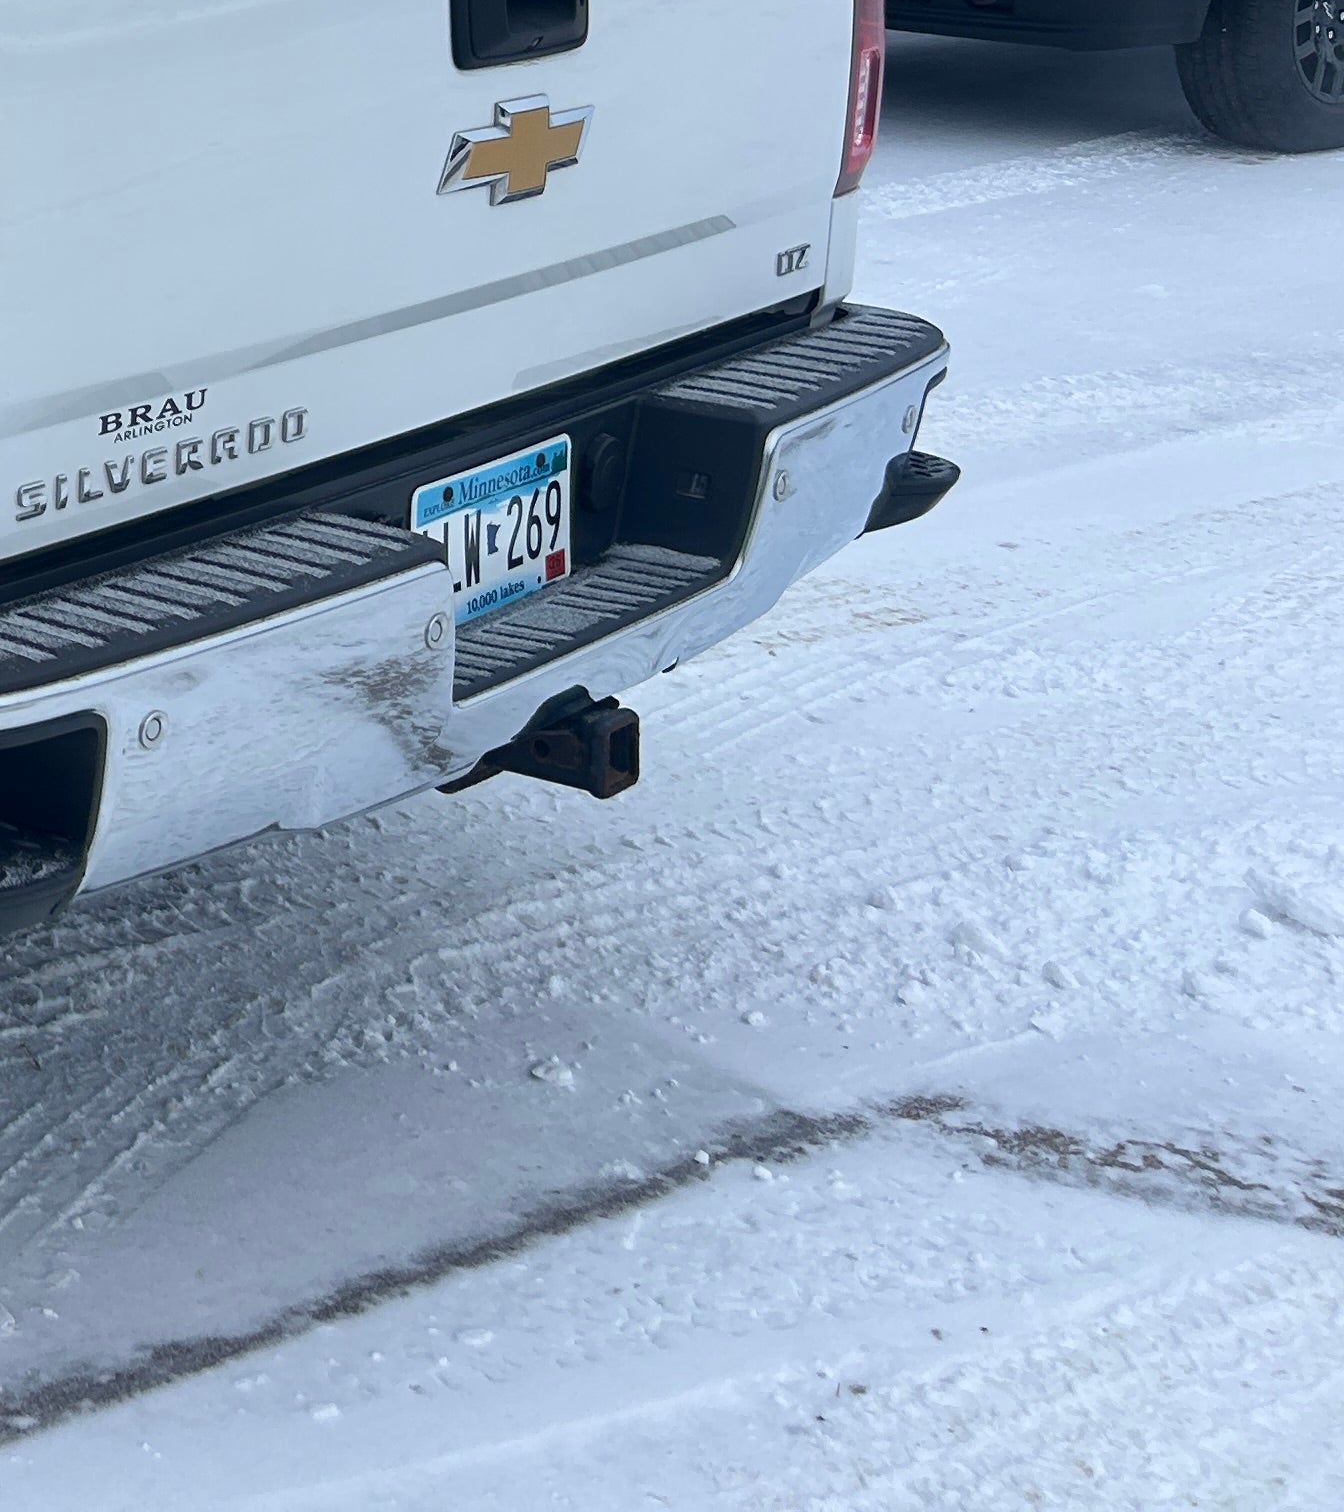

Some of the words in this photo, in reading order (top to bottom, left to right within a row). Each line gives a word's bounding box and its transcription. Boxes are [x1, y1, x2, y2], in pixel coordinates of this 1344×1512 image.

[98, 388, 208, 435] BRAU
[113, 412, 193, 444] ARLINGTON
[15, 406, 310, 522] SILVERADO
[422, 509, 481, 593] LW
[507, 479, 561, 571] 269
[466, 590, 498, 615] 10,000
[500, 579, 525, 603] lakes
